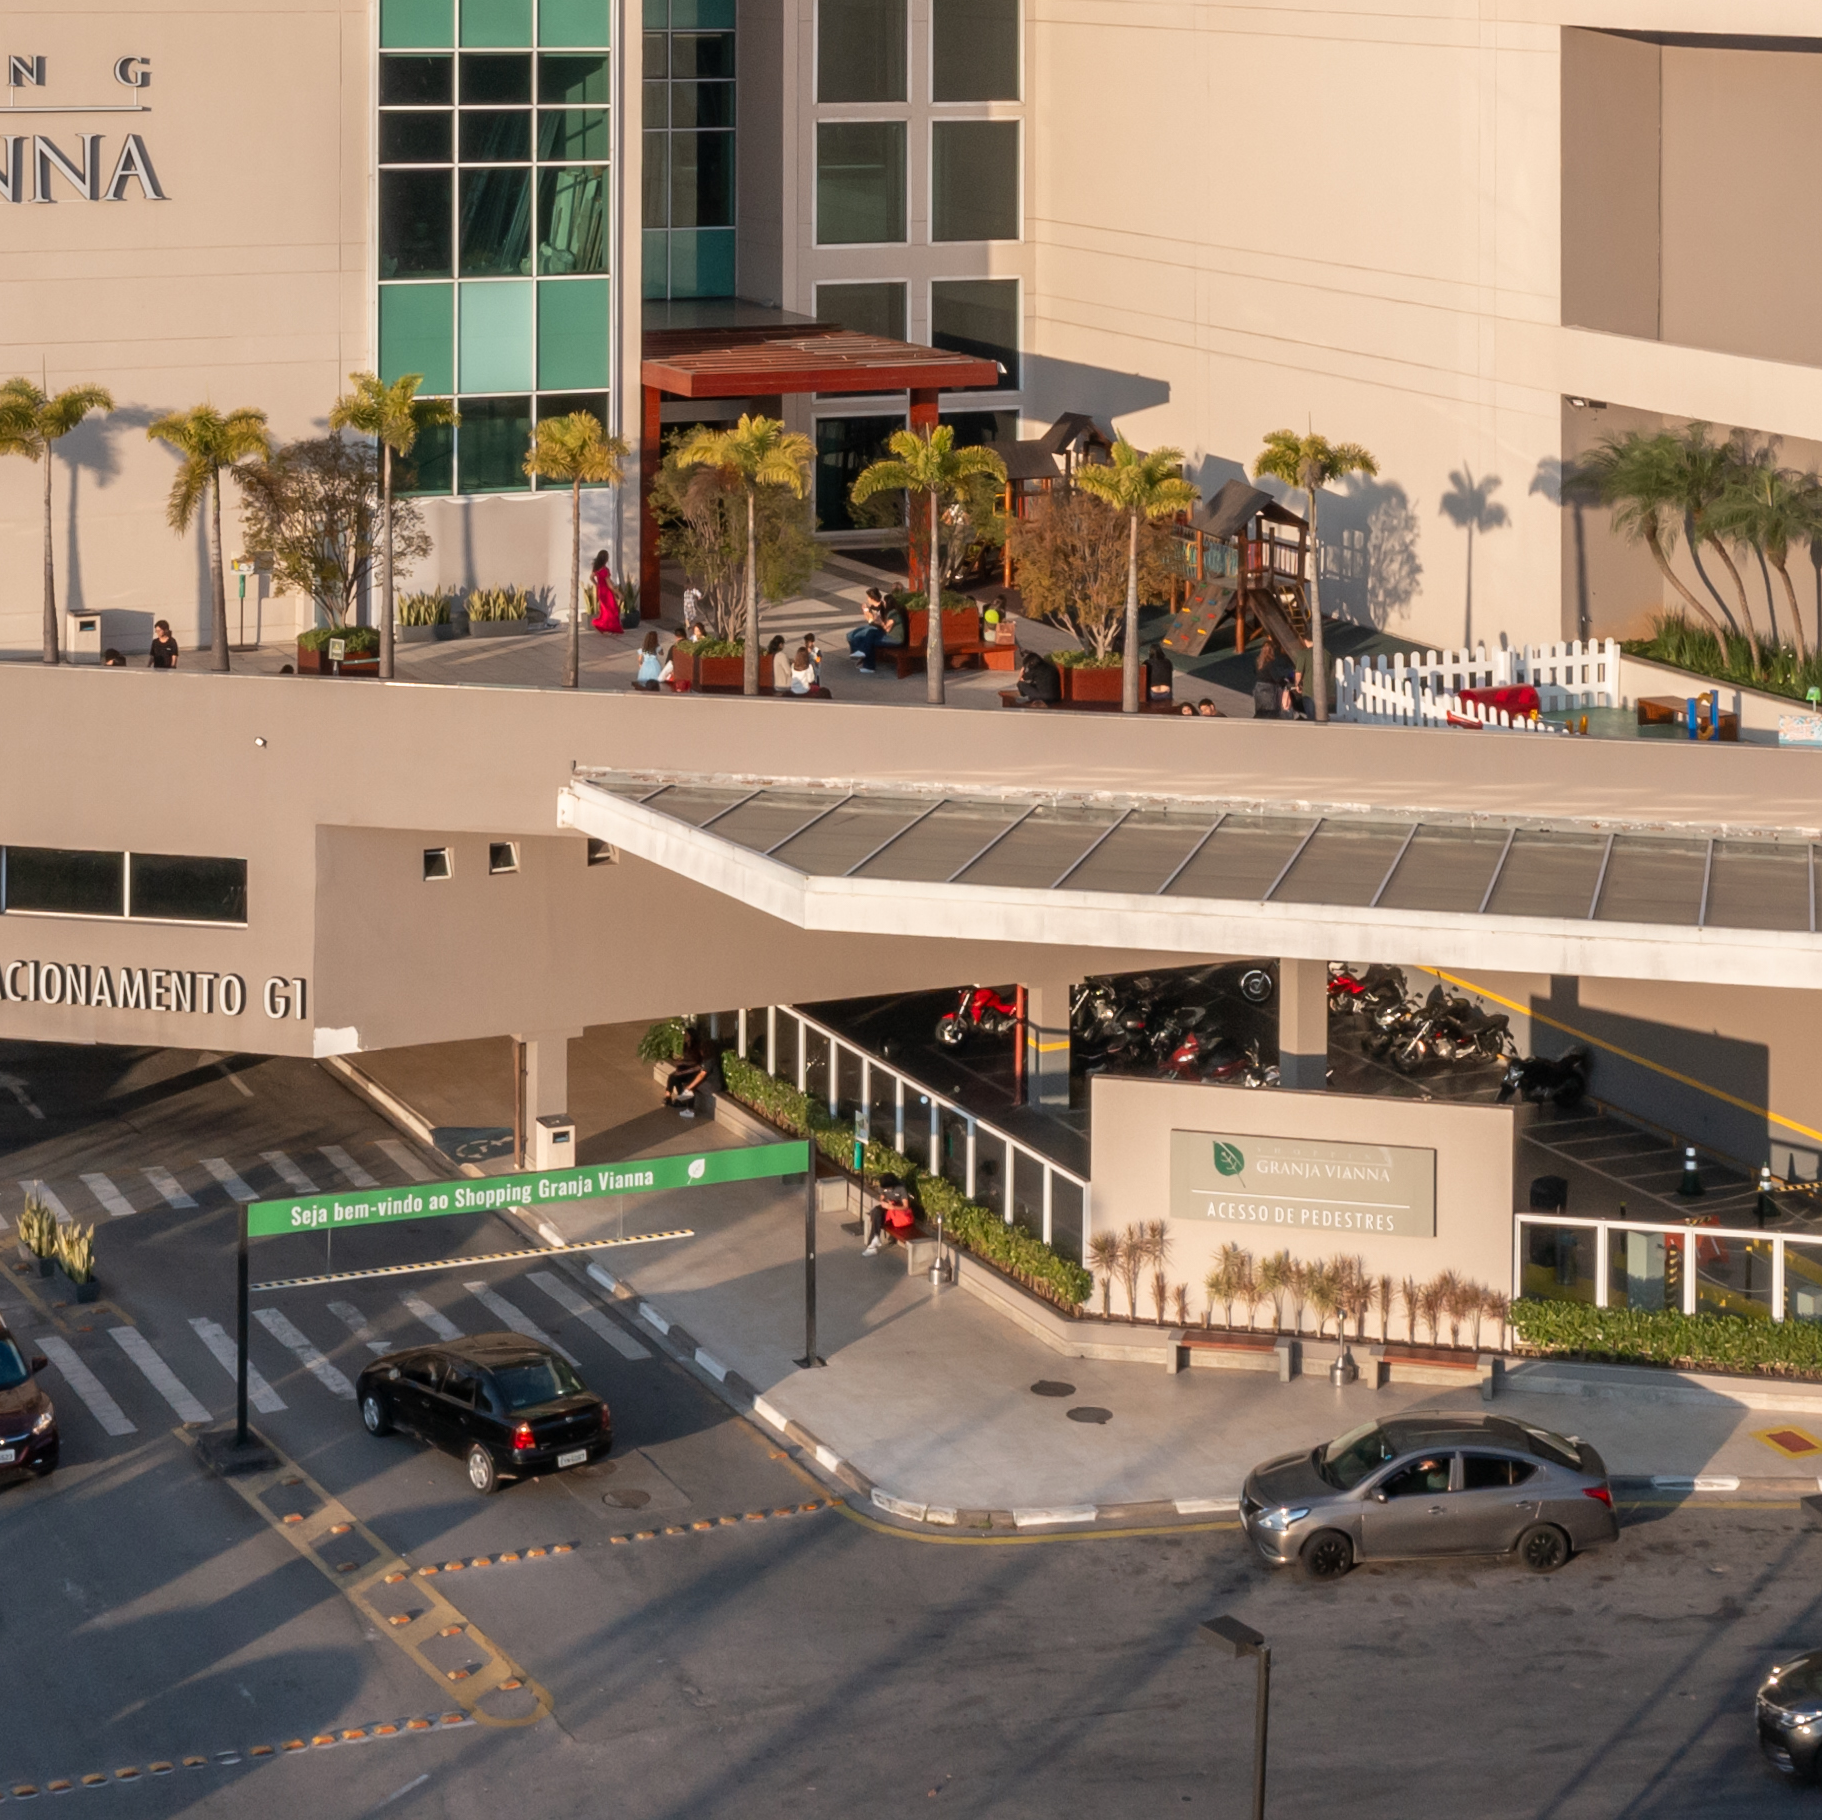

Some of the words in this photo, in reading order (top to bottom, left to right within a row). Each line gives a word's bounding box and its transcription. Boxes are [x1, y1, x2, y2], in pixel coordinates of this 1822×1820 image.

[262, 975, 307, 1020] G1
[1256, 1146, 1390, 1164] SHOPPIN
[1256, 1159, 1321, 1179] GRANJA
[1325, 1164, 1391, 1183] VIANNA
[291, 1205, 328, 1227] Seja
[333, 1193, 423, 1222] bem-vindo
[429, 1194, 449, 1211] ao
[454, 1182, 532, 1208] Shopping
[538, 1175, 593, 1199] Granja
[598, 1170, 654, 1191] Vianna
[1207, 1201, 1269, 1222] ACESSO
[1275, 1206, 1294, 1224] DE
[1301, 1208, 1395, 1232] PEDESTRES
